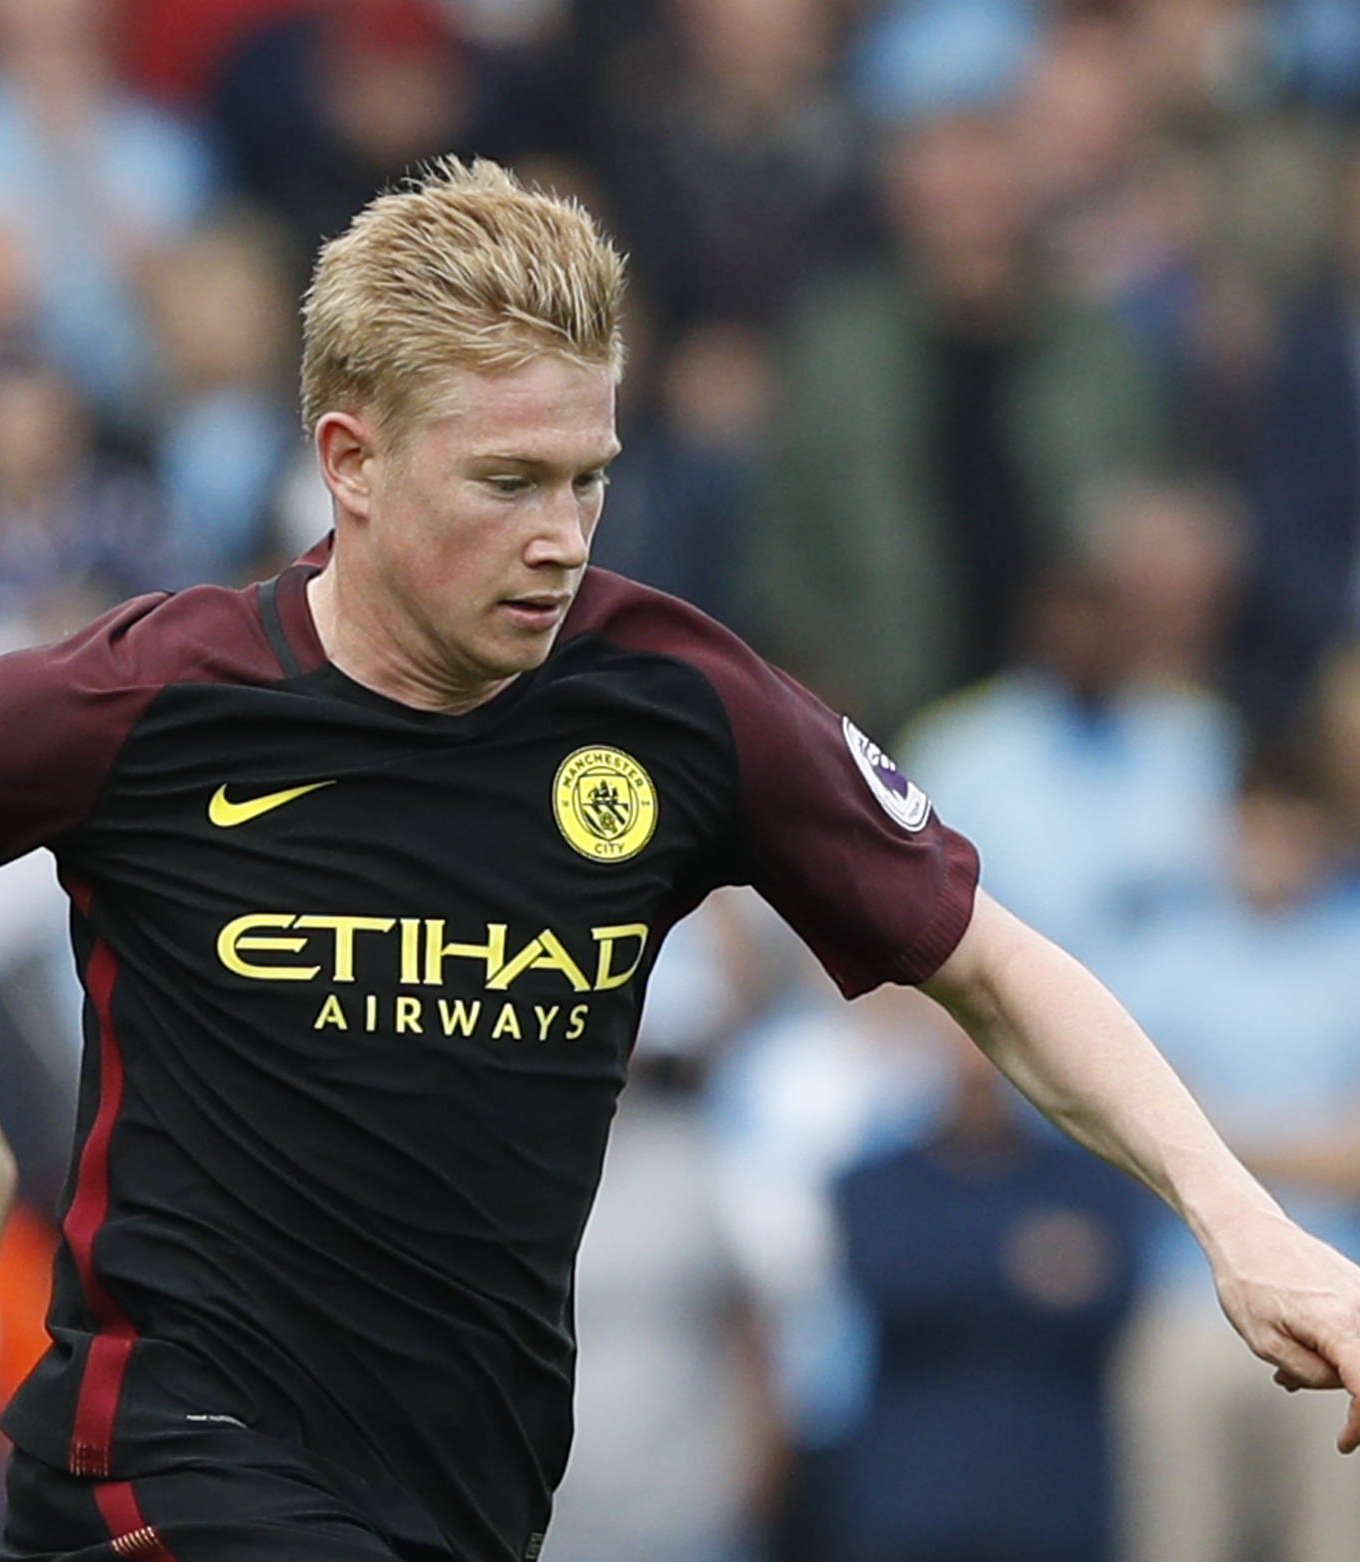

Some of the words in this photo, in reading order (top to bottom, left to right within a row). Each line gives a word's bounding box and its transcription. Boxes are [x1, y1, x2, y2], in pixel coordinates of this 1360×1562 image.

[562, 752, 644, 789] MANCHESTER
[594, 842, 626, 856] CITY
[216, 912, 650, 993] ETIHAD
[313, 994, 590, 1041] AIRWAYS
